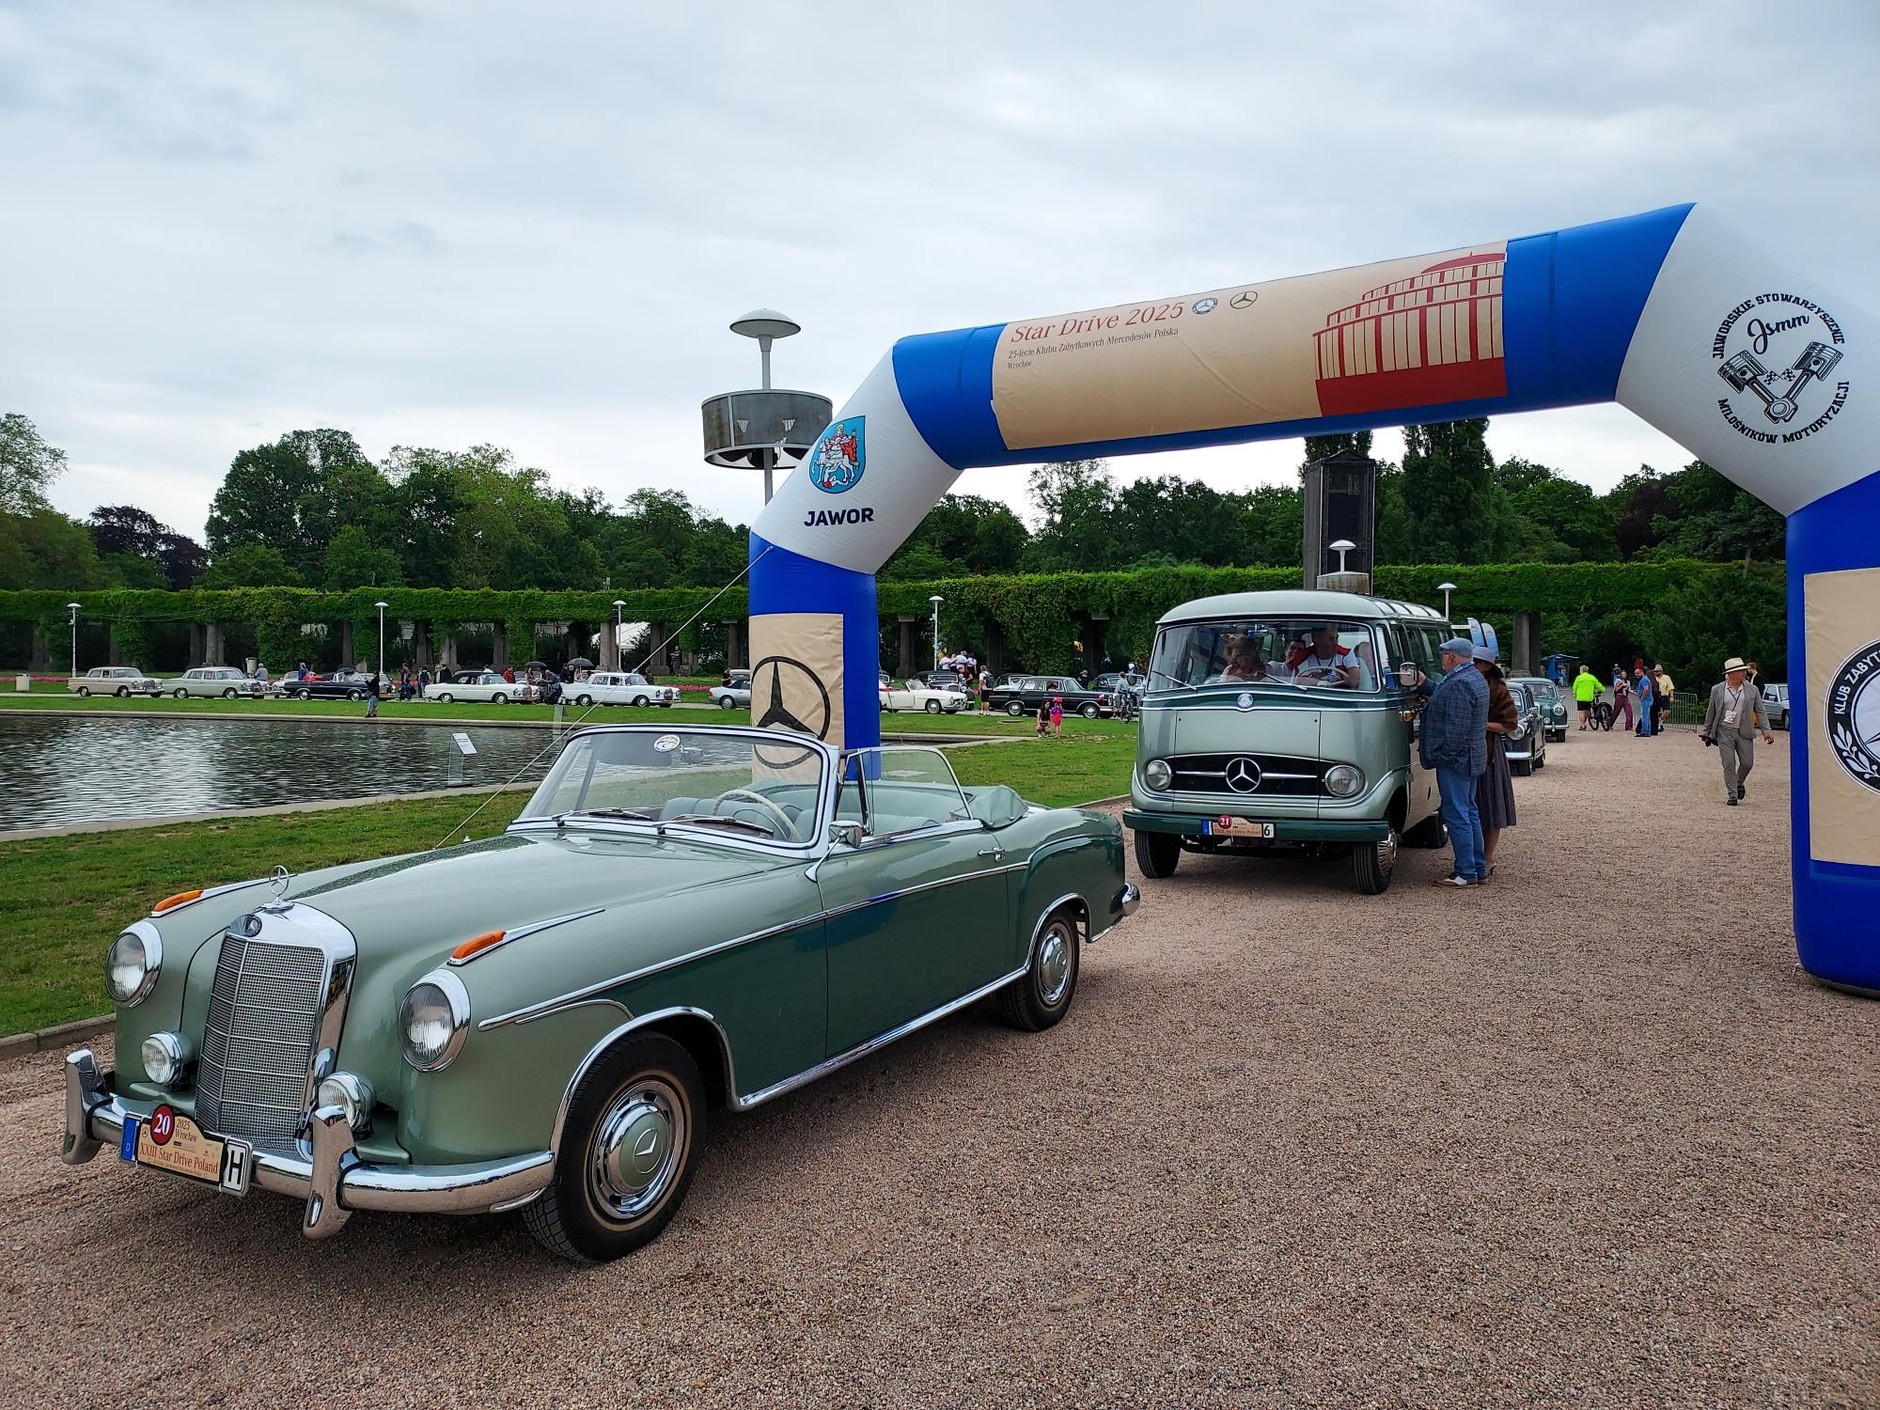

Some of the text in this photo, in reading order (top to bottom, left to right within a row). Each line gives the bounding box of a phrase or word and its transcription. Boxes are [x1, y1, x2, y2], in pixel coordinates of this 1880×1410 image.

[1010, 301, 1185, 343] Star Drive 2025
[1107, 331, 1153, 345] Mercedesów
[1154, 327, 1179, 338] Polska
[1712, 293, 1845, 359] JAWORSKIE STOWARZYSZENIE
[1747, 315, 1810, 355] Jsmm
[1782, 381, 1850, 444] MOTORYZACJI
[804, 507, 875, 527] JAWOR
[1834, 650, 1880, 715] KLUB ZABYT
[1220, 818, 1229, 826] 21
[1264, 825, 1270, 836] 6
[153, 1113, 171, 1135] 20
[176, 1118, 191, 1131] 2025
[140, 1142, 158, 1158] XXIII
[159, 1146, 173, 1162] Star
[174, 1151, 193, 1167] Drive
[194, 1156, 219, 1174] Poland
[228, 1149, 244, 1185] H
